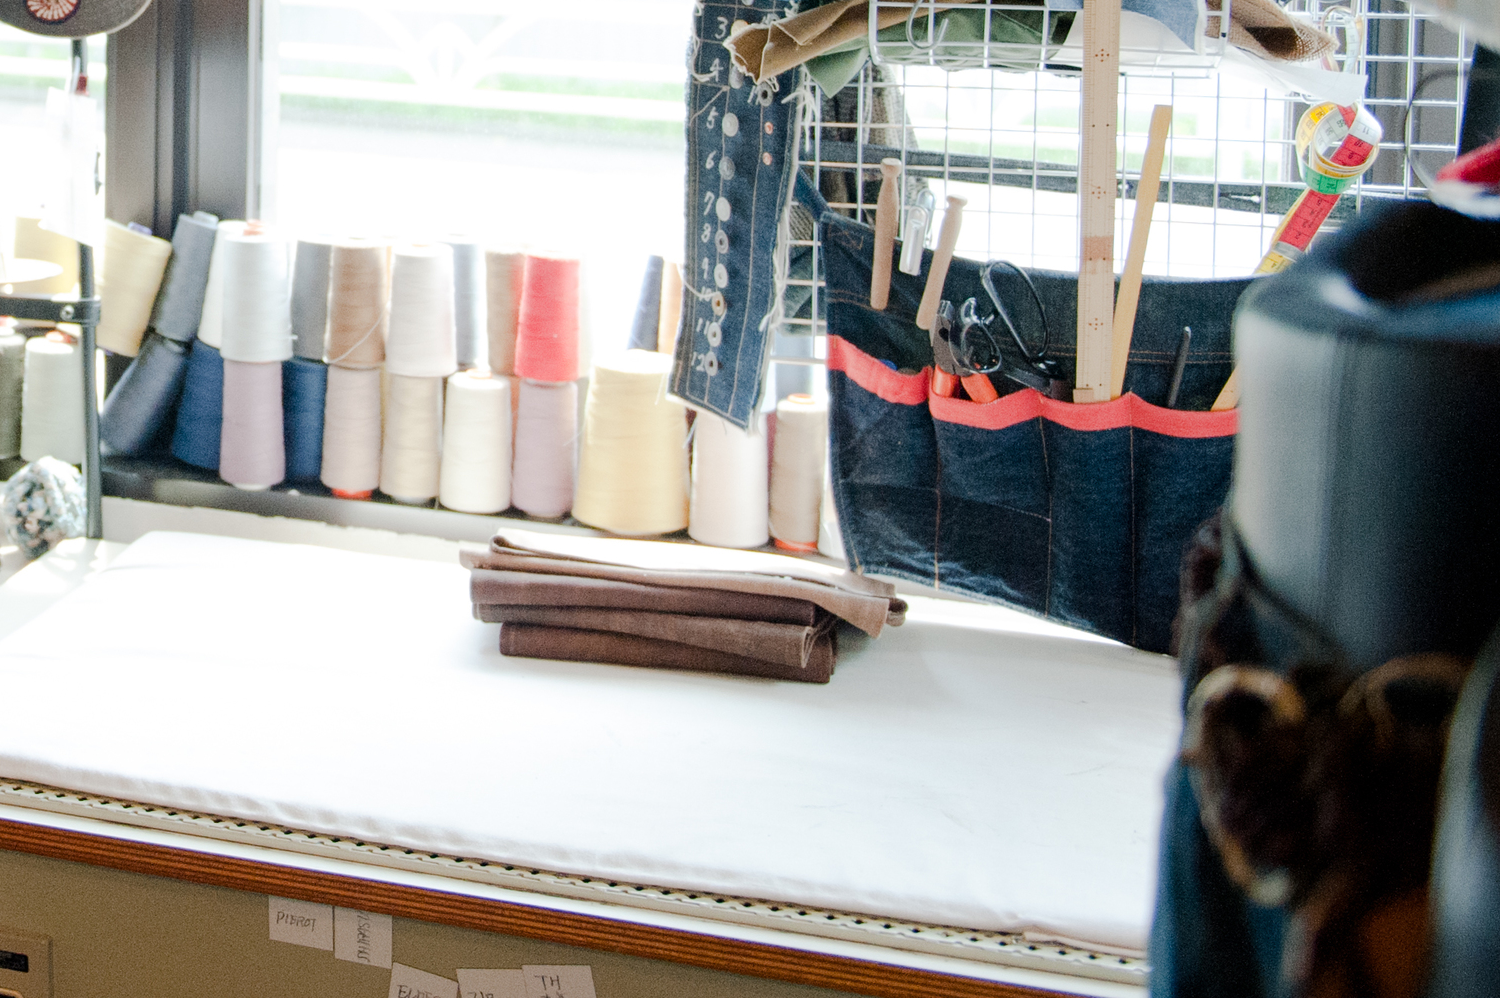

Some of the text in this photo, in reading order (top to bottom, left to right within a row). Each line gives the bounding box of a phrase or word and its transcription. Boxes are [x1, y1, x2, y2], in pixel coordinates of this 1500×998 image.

[714, 16, 729, 39] 3
[709, 58, 725, 82] 4
[706, 106, 719, 130] 5
[705, 150, 717, 170] 6
[703, 191, 715, 216] 7
[701, 223, 711, 243] 8
[701, 256, 709, 280] 9
[690, 351, 706, 371] 12
[534, 974, 562, 991] TH
